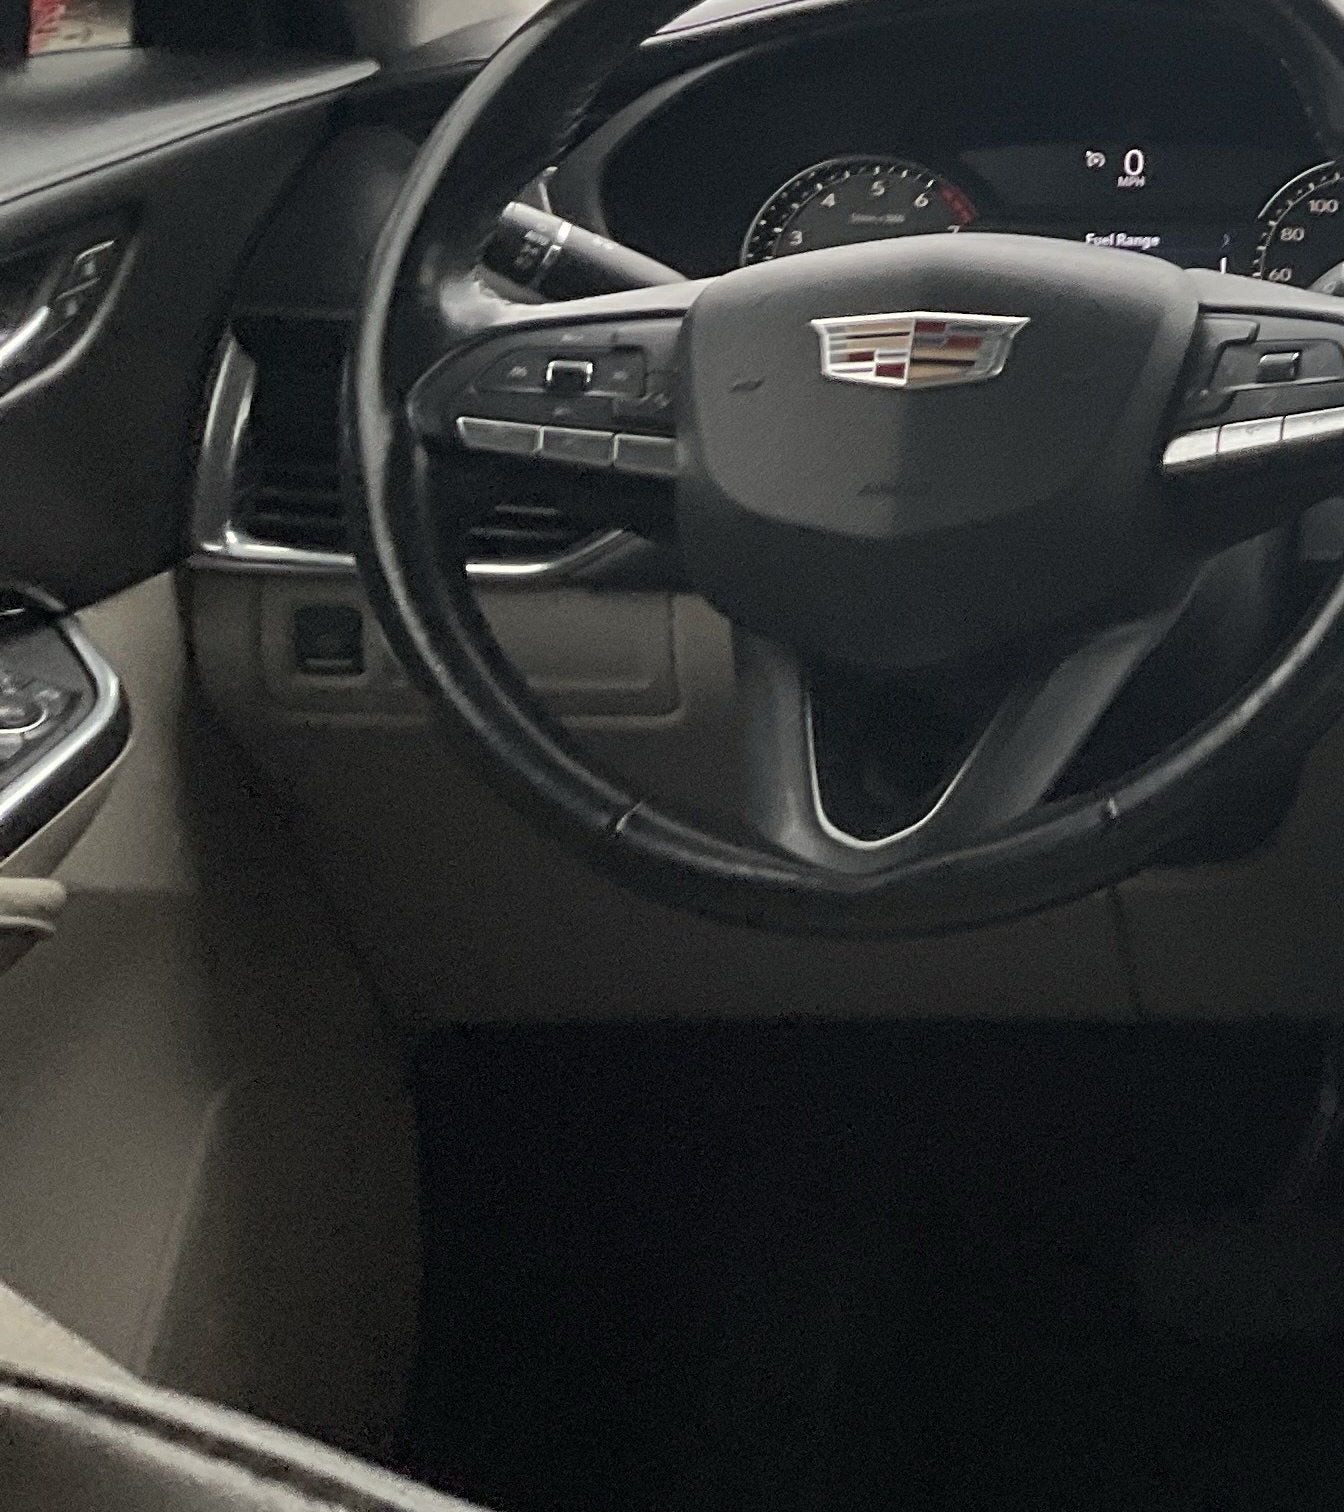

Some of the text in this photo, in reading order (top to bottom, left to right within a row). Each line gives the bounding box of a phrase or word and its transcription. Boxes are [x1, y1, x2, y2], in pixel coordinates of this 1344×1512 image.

[1123, 148, 1145, 176] 0
[871, 180, 886, 197] 5
[1117, 175, 1146, 188] MPH
[914, 192, 929, 209] 6
[1309, 199, 1340, 214] 100
[790, 230, 803, 246] 3
[1085, 232, 1161, 251] Fuel Range
[1280, 227, 1305, 242] 80
[1268, 267, 1292, 282] 60
